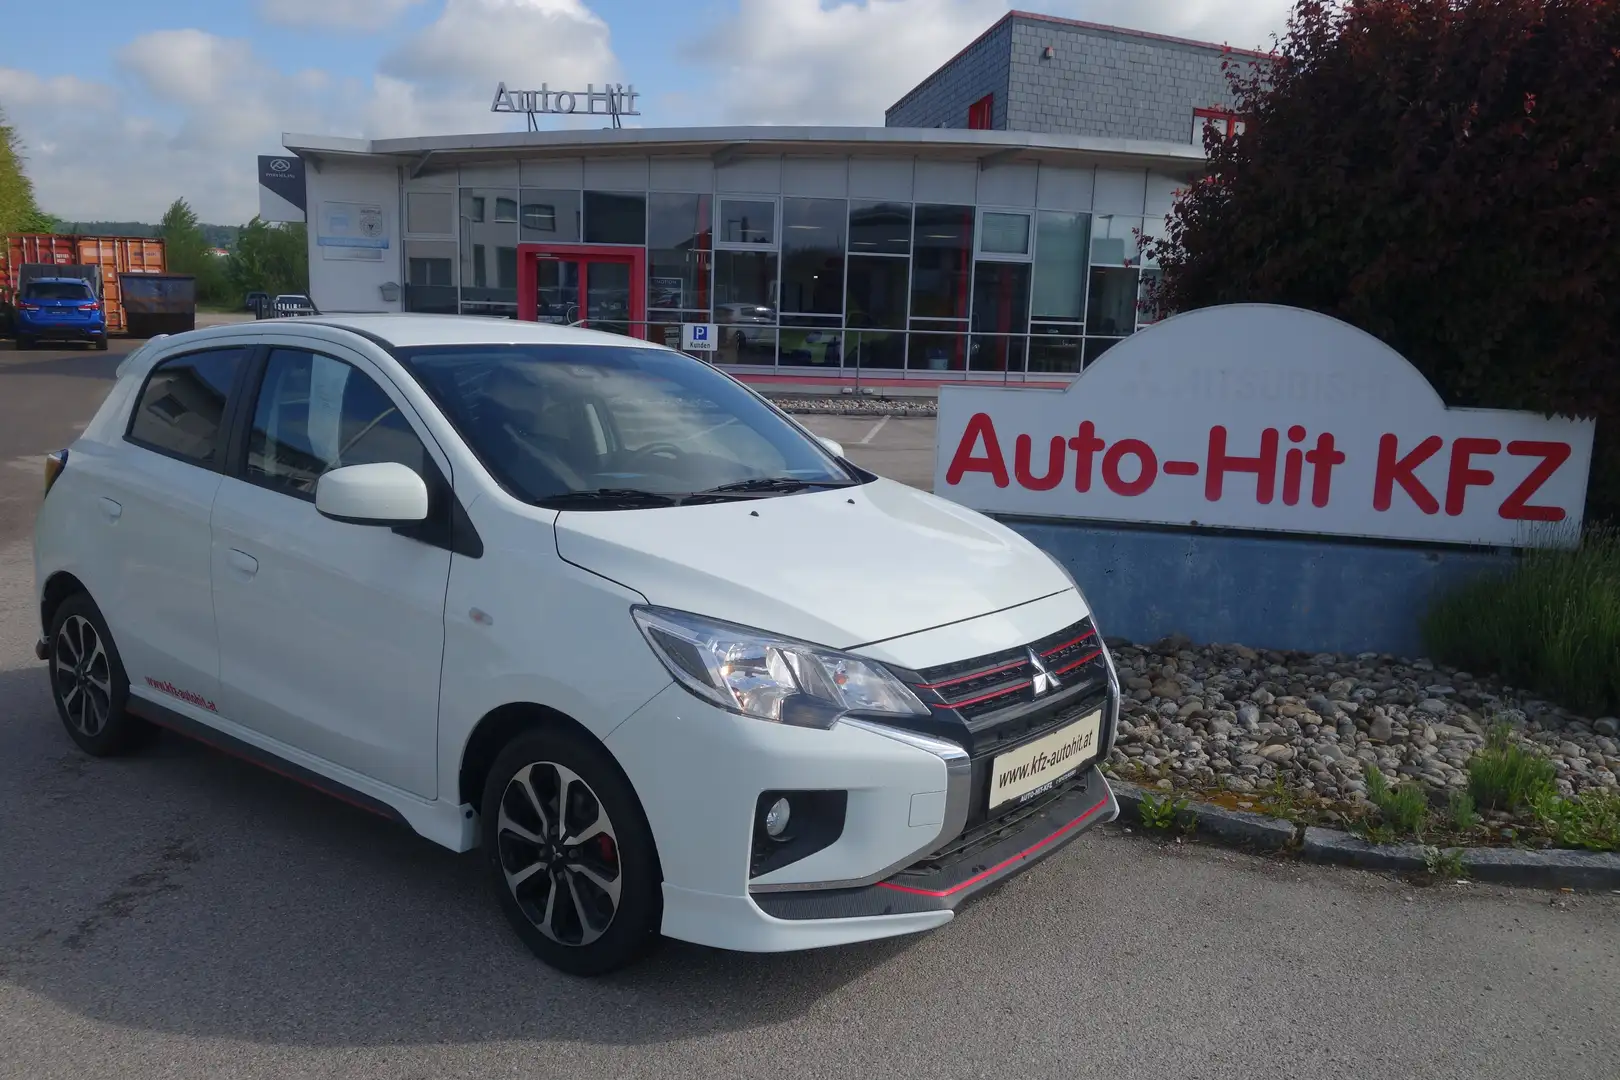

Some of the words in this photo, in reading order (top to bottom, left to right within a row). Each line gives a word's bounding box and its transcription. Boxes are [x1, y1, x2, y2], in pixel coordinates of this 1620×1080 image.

[491, 81, 576, 113] Auto
[587, 83, 640, 114] Hit
[690, 341, 711, 349] Kunden
[696, 327, 704, 340] P
[945, 412, 1346, 507] Auto-Hit
[1372, 433, 1572, 521] KFZ
[999, 729, 1093, 789] www.kfz-autohit.at
